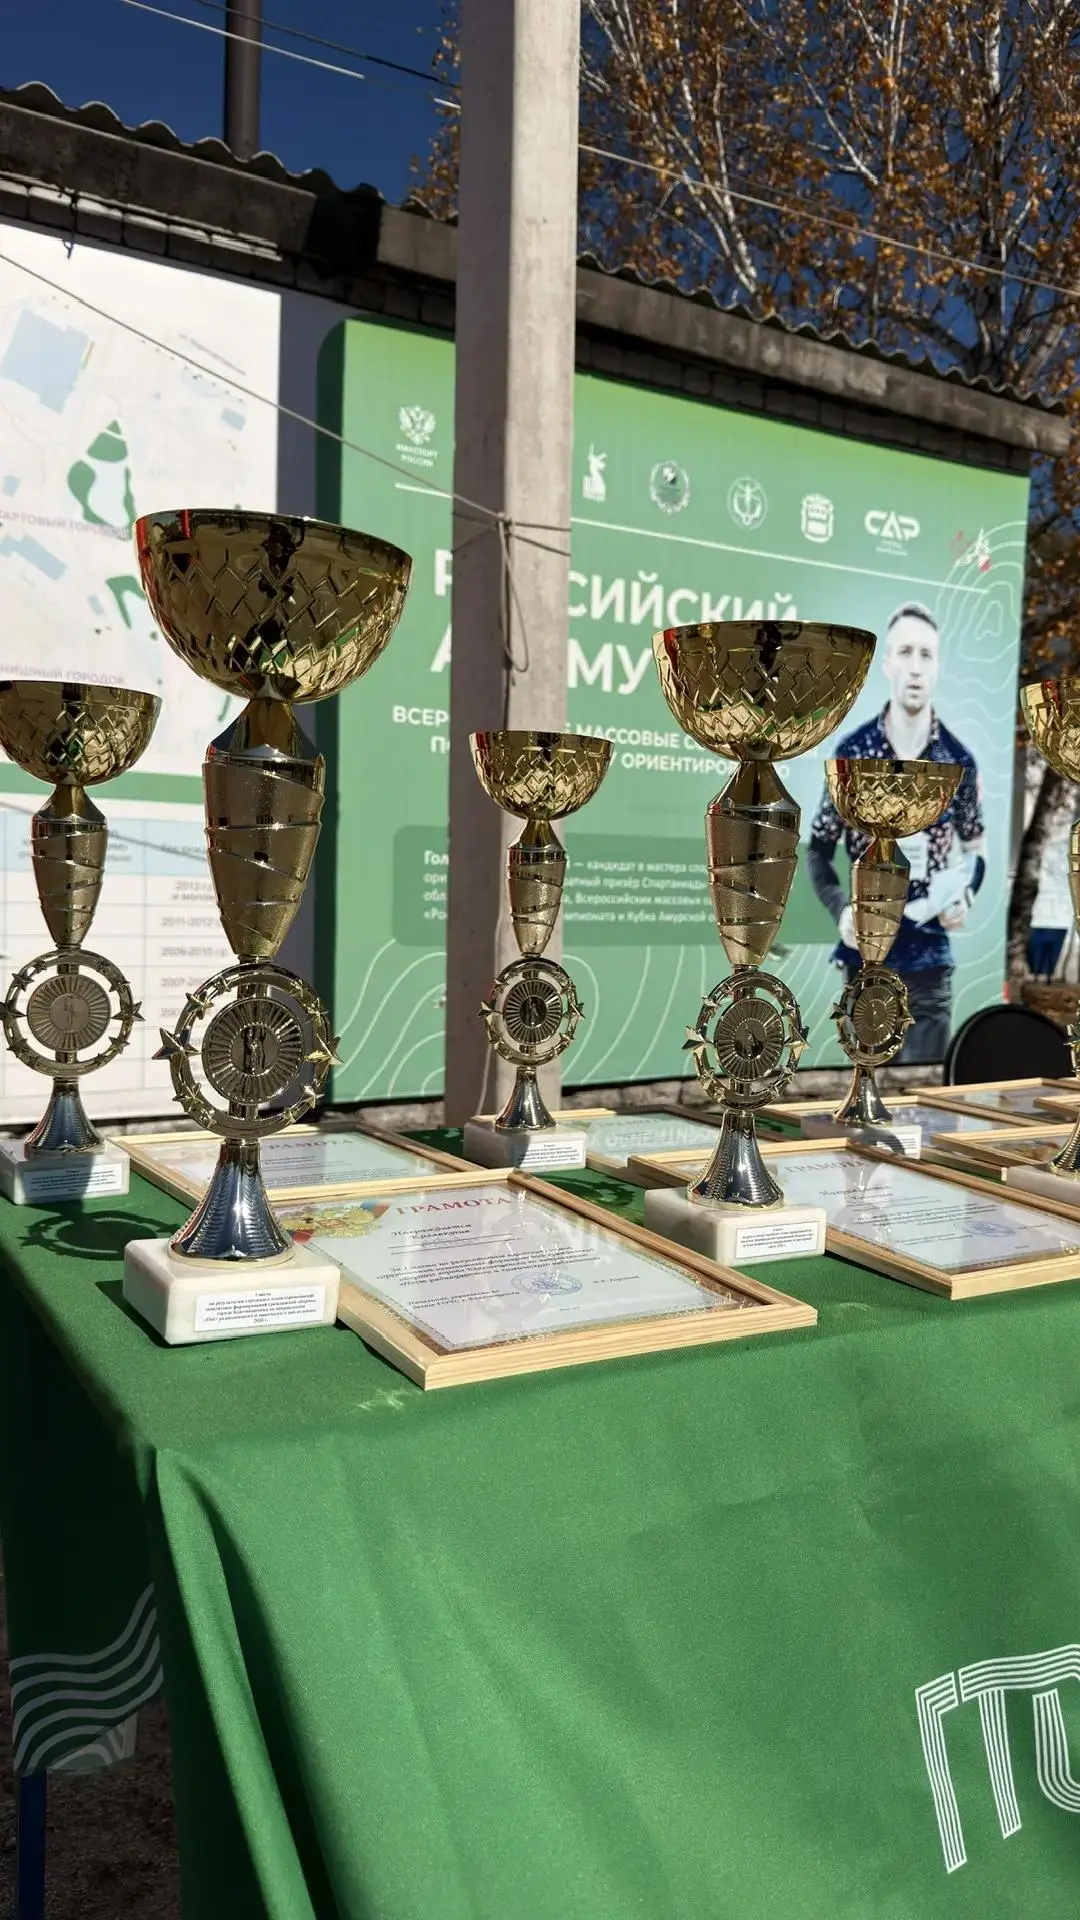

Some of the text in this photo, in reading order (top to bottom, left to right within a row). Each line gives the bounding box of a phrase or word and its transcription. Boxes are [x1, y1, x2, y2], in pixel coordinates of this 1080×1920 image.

[576, 723, 680, 749] МАССОВЫЕ
[268, 1138, 353, 1150] РАМОТА
[396, 1197, 512, 1214] ГРАМОТА
